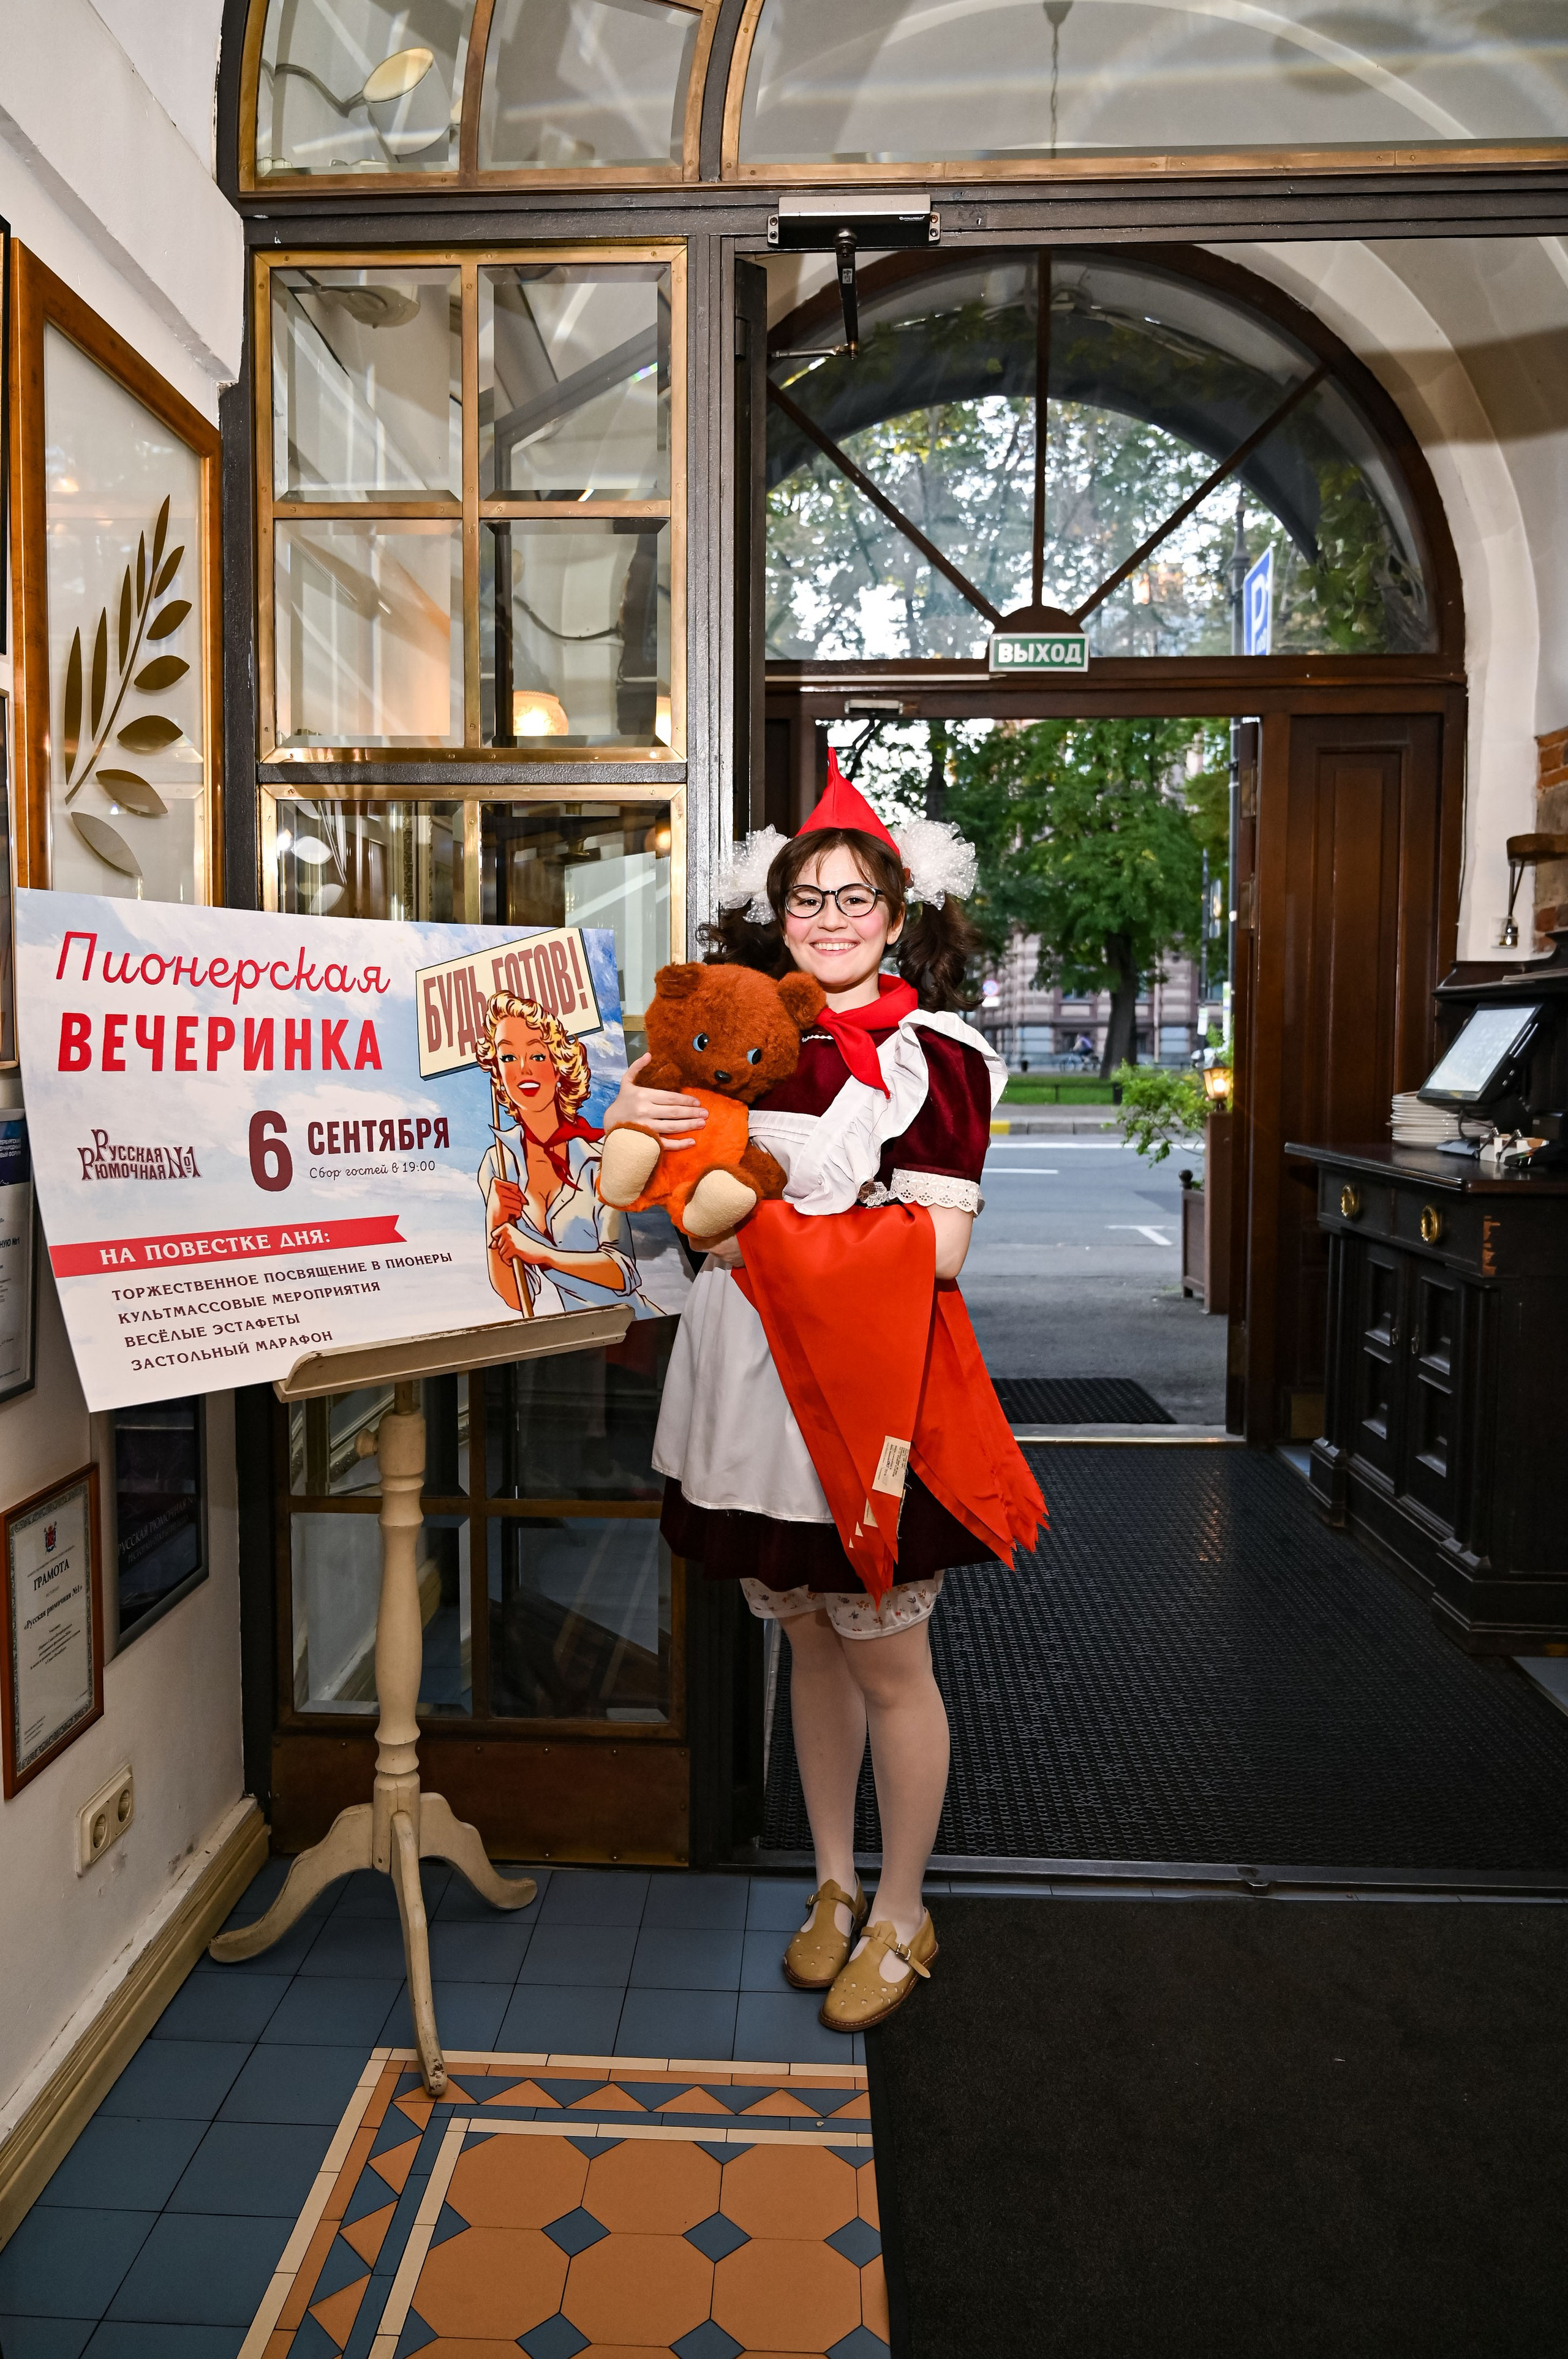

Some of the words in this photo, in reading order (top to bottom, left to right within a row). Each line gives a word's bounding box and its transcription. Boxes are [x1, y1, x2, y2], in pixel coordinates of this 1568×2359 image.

[997, 643, 1082, 664] ВЫХОД
[56, 931, 391, 1005] Пионерская
[423, 965, 488, 1057] БУДЬ
[58, 1012, 383, 1072] ВЕЧЕРИНКА
[249, 1110, 293, 1192] 6
[307, 1117, 450, 1155] СЕНТЯБРЯ
[309, 1168, 341, 1180] Сбор
[345, 1164, 388, 1176] гостей
[392, 1162, 399, 1173] в
[402, 1160, 435, 1172] 19:00
[100, 1247, 136, 1266] НА
[145, 1234, 271, 1261] ПОВЕСТКЕ
[279, 1229, 331, 1248] ДНЯ:
[111, 1274, 258, 1301] ТОРЖЕСТВЕННОЕ
[263, 1262, 368, 1283] ПОСВЯЩЕНИЕ
[371, 1259, 380, 1270] В
[385, 1253, 452, 1269] ПИОНЕРЫ
[118, 1296, 266, 1324] КУЛЬТМАССОВЫЕ
[272, 1281, 380, 1304] МЕРОПРИЯТИЯ
[124, 1325, 207, 1348] ВЕСЁЛЫЕ
[213, 1313, 300, 1335] ЭСТАФЕТЫ
[130, 1342, 250, 1371] ЗАСТОЛЬНЫЙ
[255, 1330, 333, 1352] МАРАФОН
[34, 1558, 70, 1591] ГРАМОТА
[24, 1611, 46, 1629] «Русская
